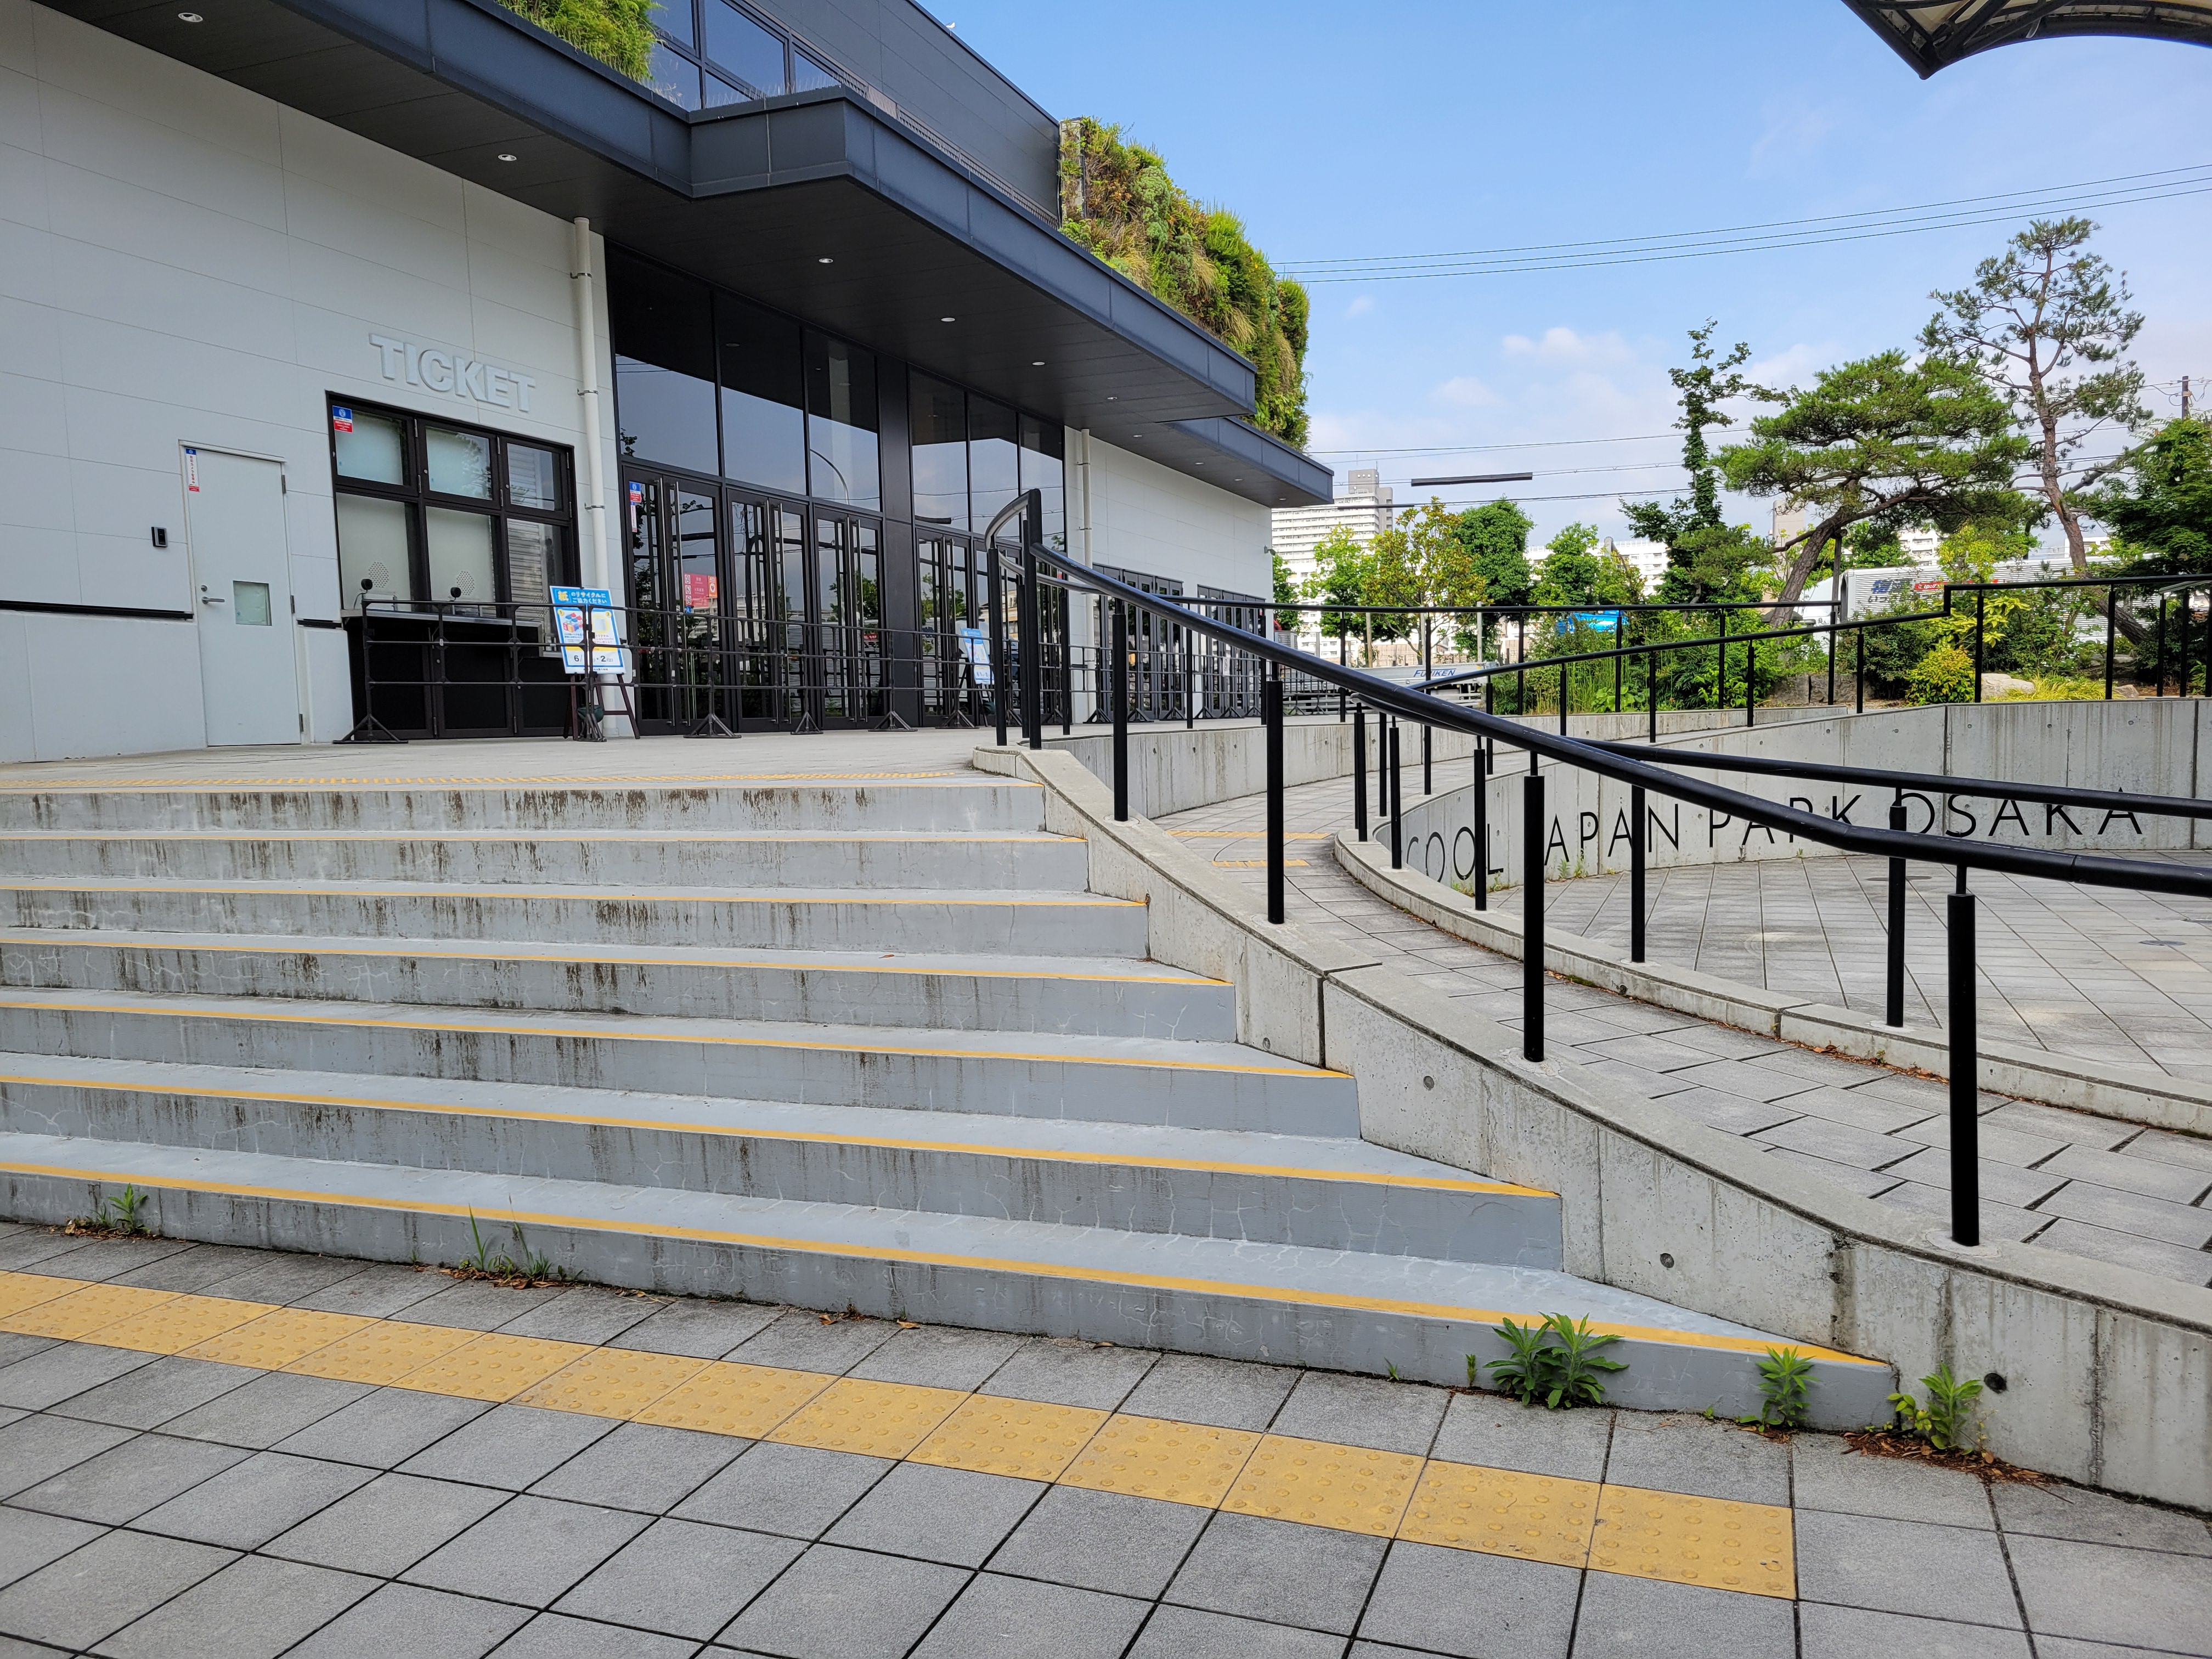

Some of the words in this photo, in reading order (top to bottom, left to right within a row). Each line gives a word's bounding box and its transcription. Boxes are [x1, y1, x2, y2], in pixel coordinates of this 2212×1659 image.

[369, 333, 535, 413] TICKET
[1413, 668, 1457, 677] FUIKEN
[1407, 823, 1504, 882] COOL
[1544, 803, 1679, 866] APAN
[1889, 786, 2143, 838] OSAKA
